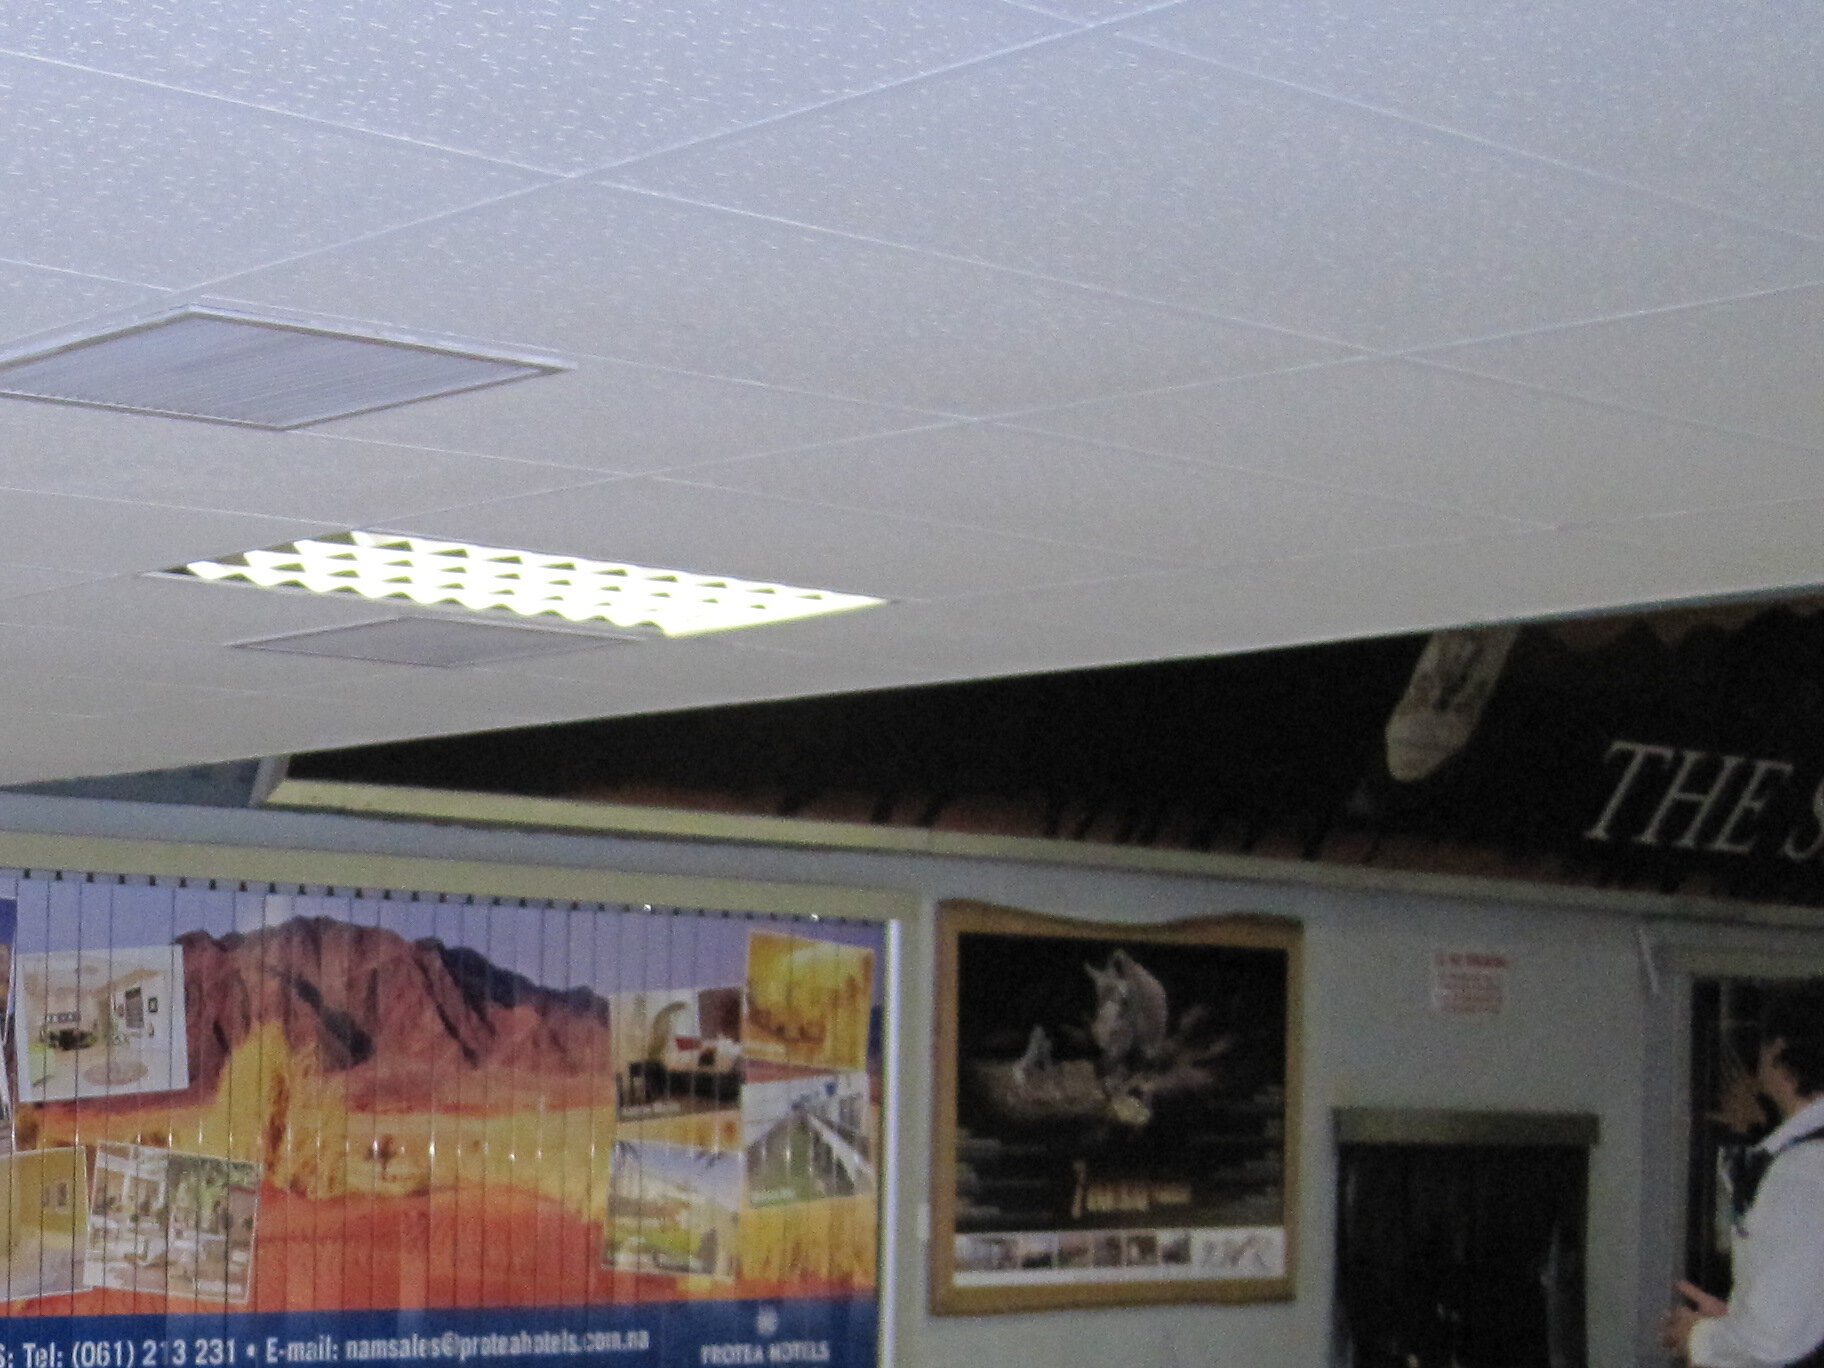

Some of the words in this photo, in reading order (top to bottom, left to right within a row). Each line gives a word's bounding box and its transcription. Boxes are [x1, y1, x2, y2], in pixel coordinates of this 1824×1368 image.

[1583, 740, 1793, 853] THE
[23, 1341, 63, 1368] Tel:
[73, 1340, 134, 1368] (061)
[195, 1338, 234, 1365] 231
[266, 1334, 338, 1363] E-mail:
